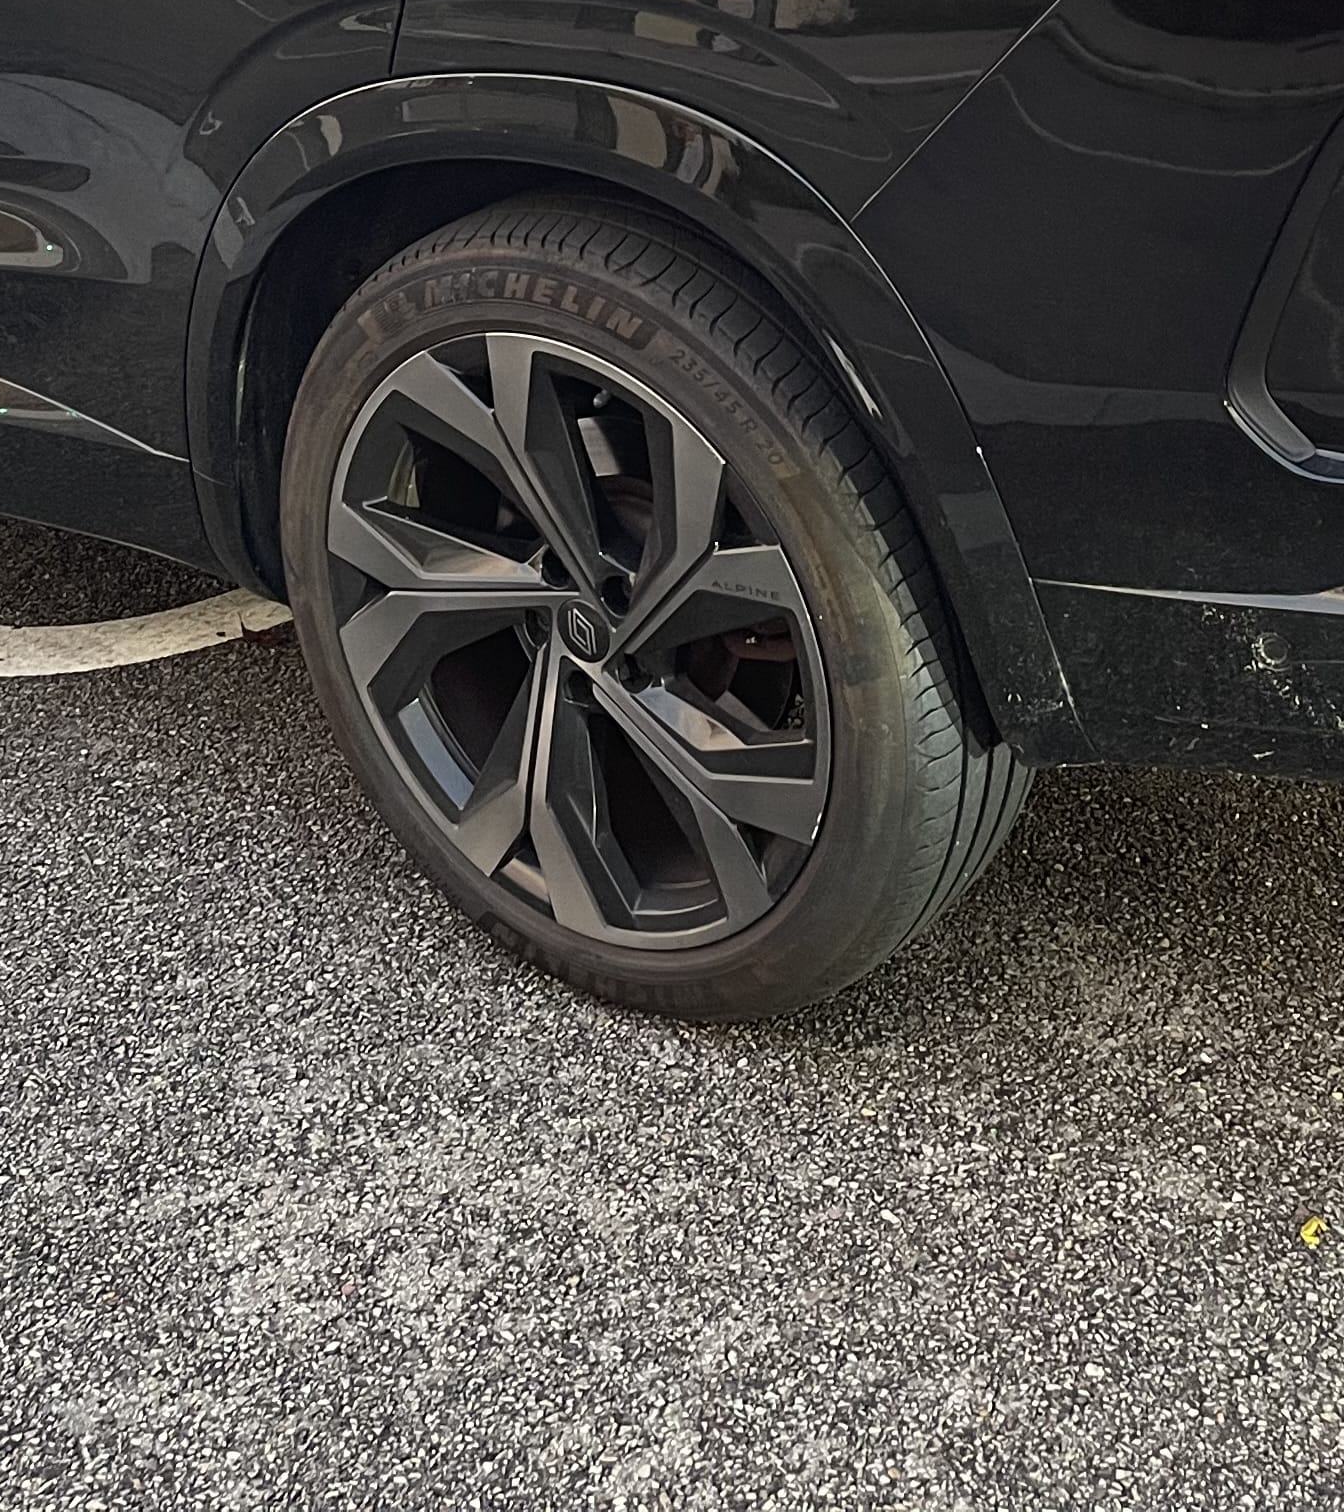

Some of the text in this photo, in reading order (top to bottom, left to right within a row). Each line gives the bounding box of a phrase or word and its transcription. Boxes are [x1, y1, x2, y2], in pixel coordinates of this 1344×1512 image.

[424, 271, 643, 338] MICHELIN
[670, 348, 744, 415] 235/45
[711, 579, 780, 601] ALPINE
